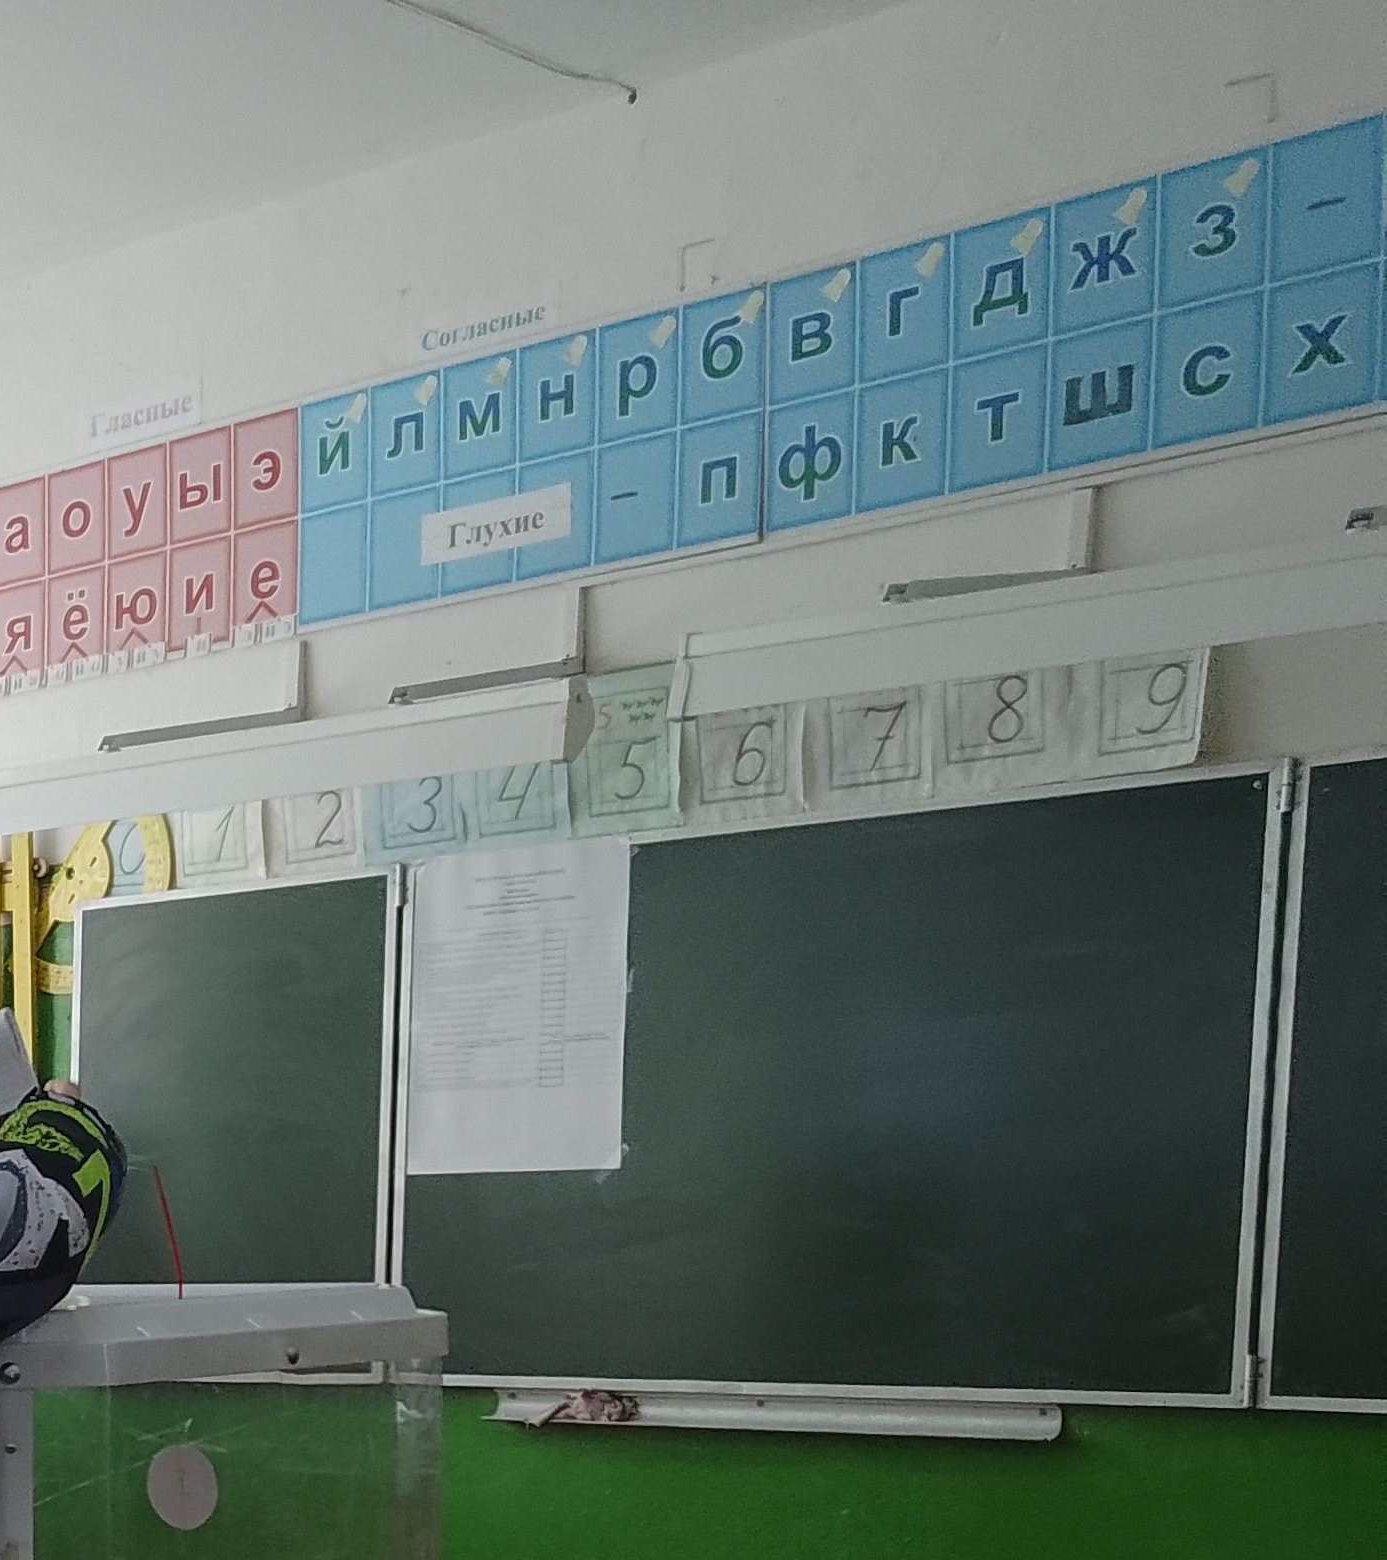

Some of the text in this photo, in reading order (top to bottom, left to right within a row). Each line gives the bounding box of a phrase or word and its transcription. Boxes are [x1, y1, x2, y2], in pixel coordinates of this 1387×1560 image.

[422, 305, 546, 351] Согласные
[3, 203, 1237, 554] а о у ы э й л м н р б в г д ж з
[91, 395, 192, 438] Гласные
[699, 313, 1348, 504] п ф к т ш с х
[447, 506, 545, 551] Глухие
[3, 559, 281, 656] я ё ю и е
[214, 806, 235, 861] 1
[313, 789, 343, 849] 2
[408, 775, 441, 833] 3
[496, 760, 539, 821] 4
[614, 735, 660, 800] 5
[733, 719, 774, 786] 6
[863, 701, 908, 771] 7
[987, 674, 1027, 744] 8
[1136, 662, 1188, 735] 9
